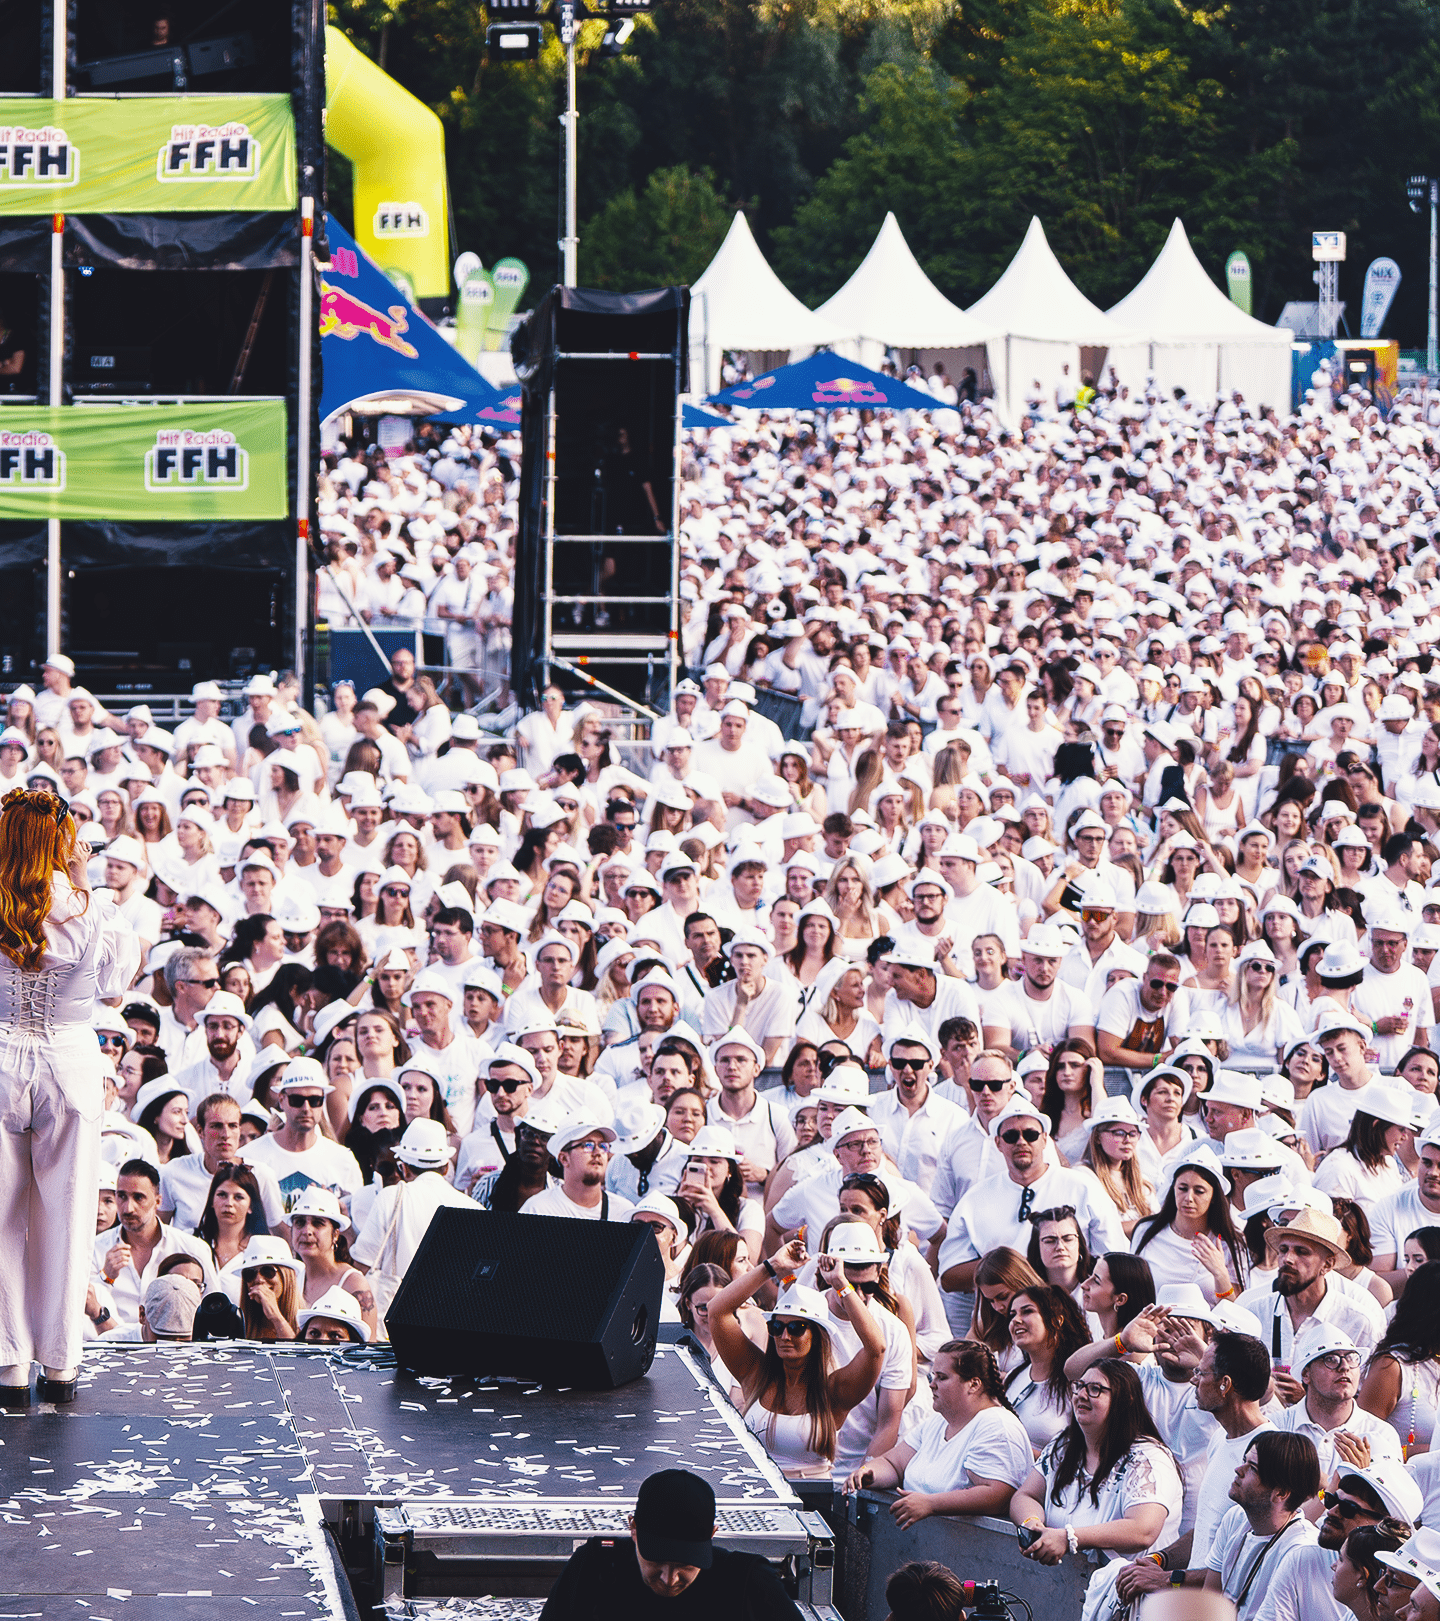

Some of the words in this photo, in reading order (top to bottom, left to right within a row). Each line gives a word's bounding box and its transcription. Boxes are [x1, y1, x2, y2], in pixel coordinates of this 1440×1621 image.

[15, 129, 64, 142] Radio
[174, 128, 194, 140] Hit
[199, 124, 245, 138] Radio
[169, 139, 249, 170] FFH
[379, 212, 421, 229] FFH
[1, 433, 49, 446] Radio
[159, 433, 180, 445] Hit
[184, 432, 232, 445] Radio
[157, 448, 237, 478] FFH
